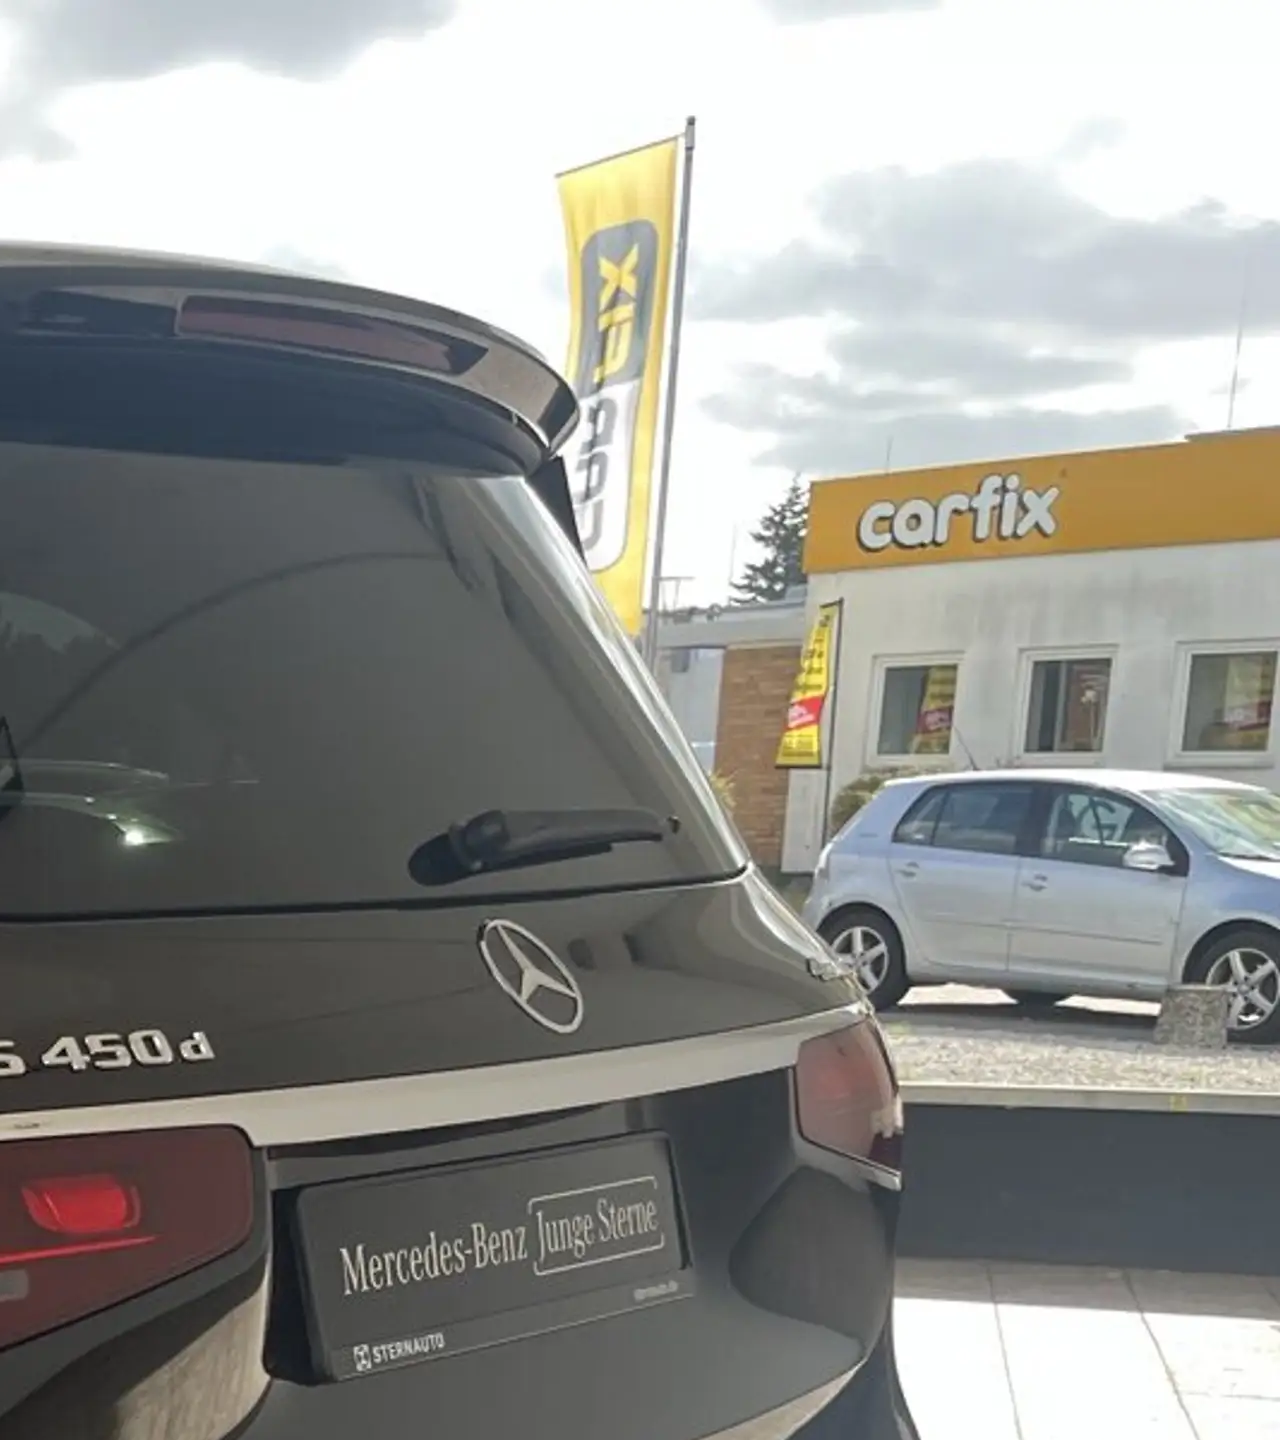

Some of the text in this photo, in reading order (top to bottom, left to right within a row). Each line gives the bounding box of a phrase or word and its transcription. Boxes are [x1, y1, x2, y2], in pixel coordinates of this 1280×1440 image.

[857, 473, 1060, 552] carfix
[339, 1198, 659, 1297] Mercedes-Benz Junge Sterne
[371, 1331, 446, 1365] STERNAUTO
